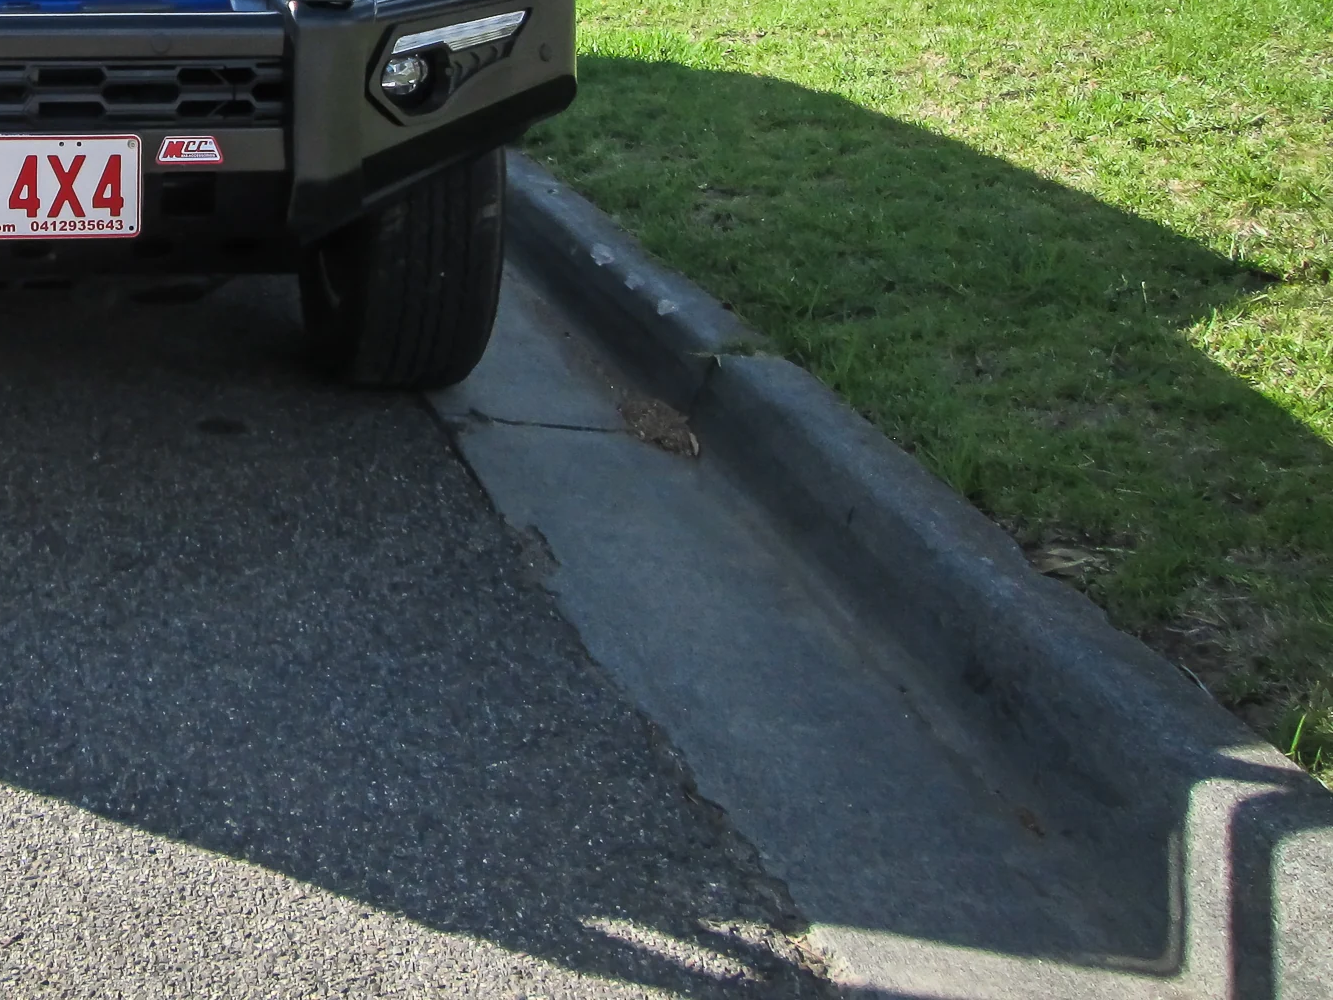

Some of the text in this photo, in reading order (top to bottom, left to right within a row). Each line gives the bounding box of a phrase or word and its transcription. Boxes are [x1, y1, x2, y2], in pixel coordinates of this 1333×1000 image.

[162, 140, 215, 158] MCC
[8, 154, 125, 218] 4X4
[30, 219, 124, 232] 0412935643
